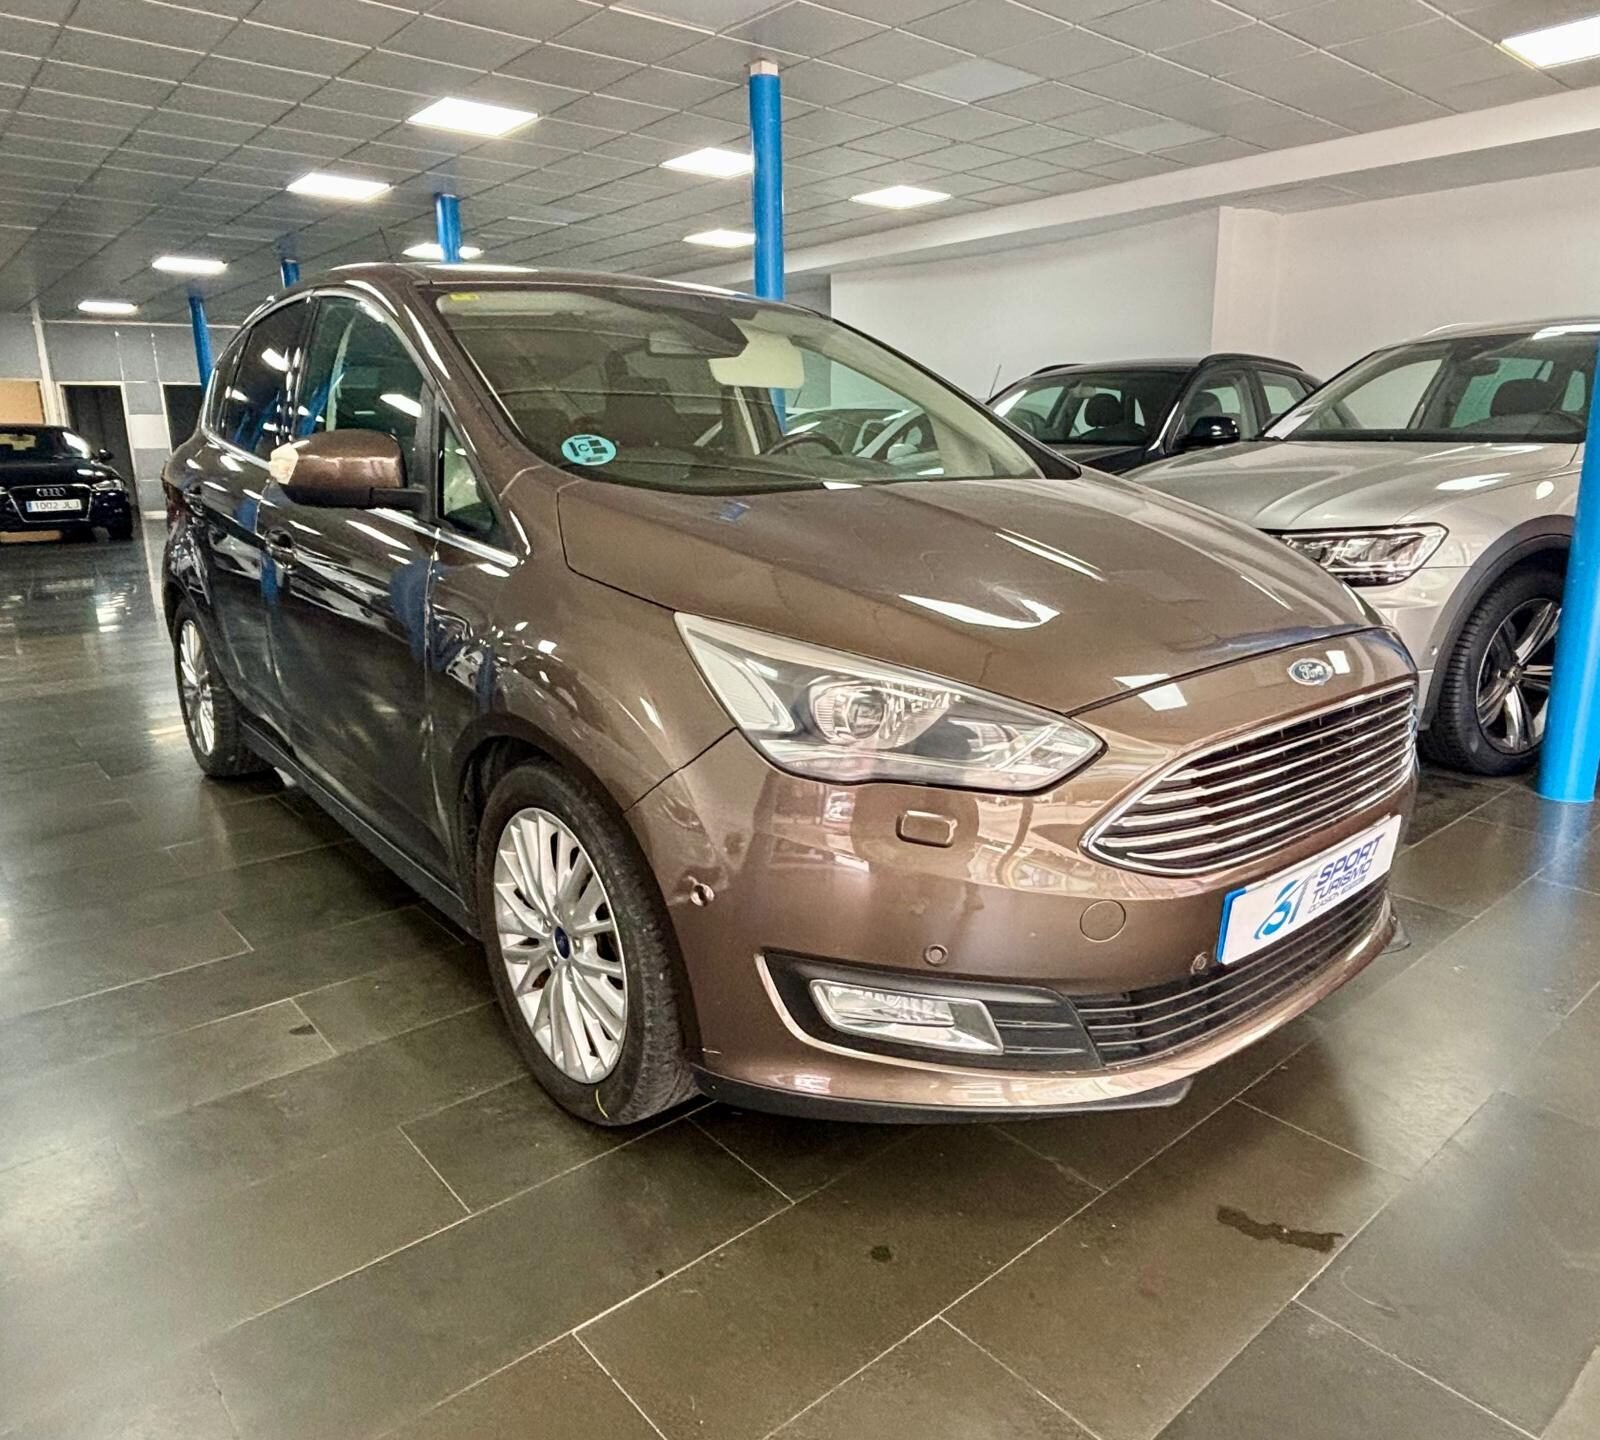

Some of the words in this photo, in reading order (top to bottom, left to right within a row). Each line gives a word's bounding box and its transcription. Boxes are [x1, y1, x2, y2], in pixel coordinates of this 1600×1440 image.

[35, 502, 58, 510] 1002
[1299, 663, 1325, 680] Ford
[1316, 832, 1385, 888] SPORT
[1312, 858, 1373, 904] TURISMO
